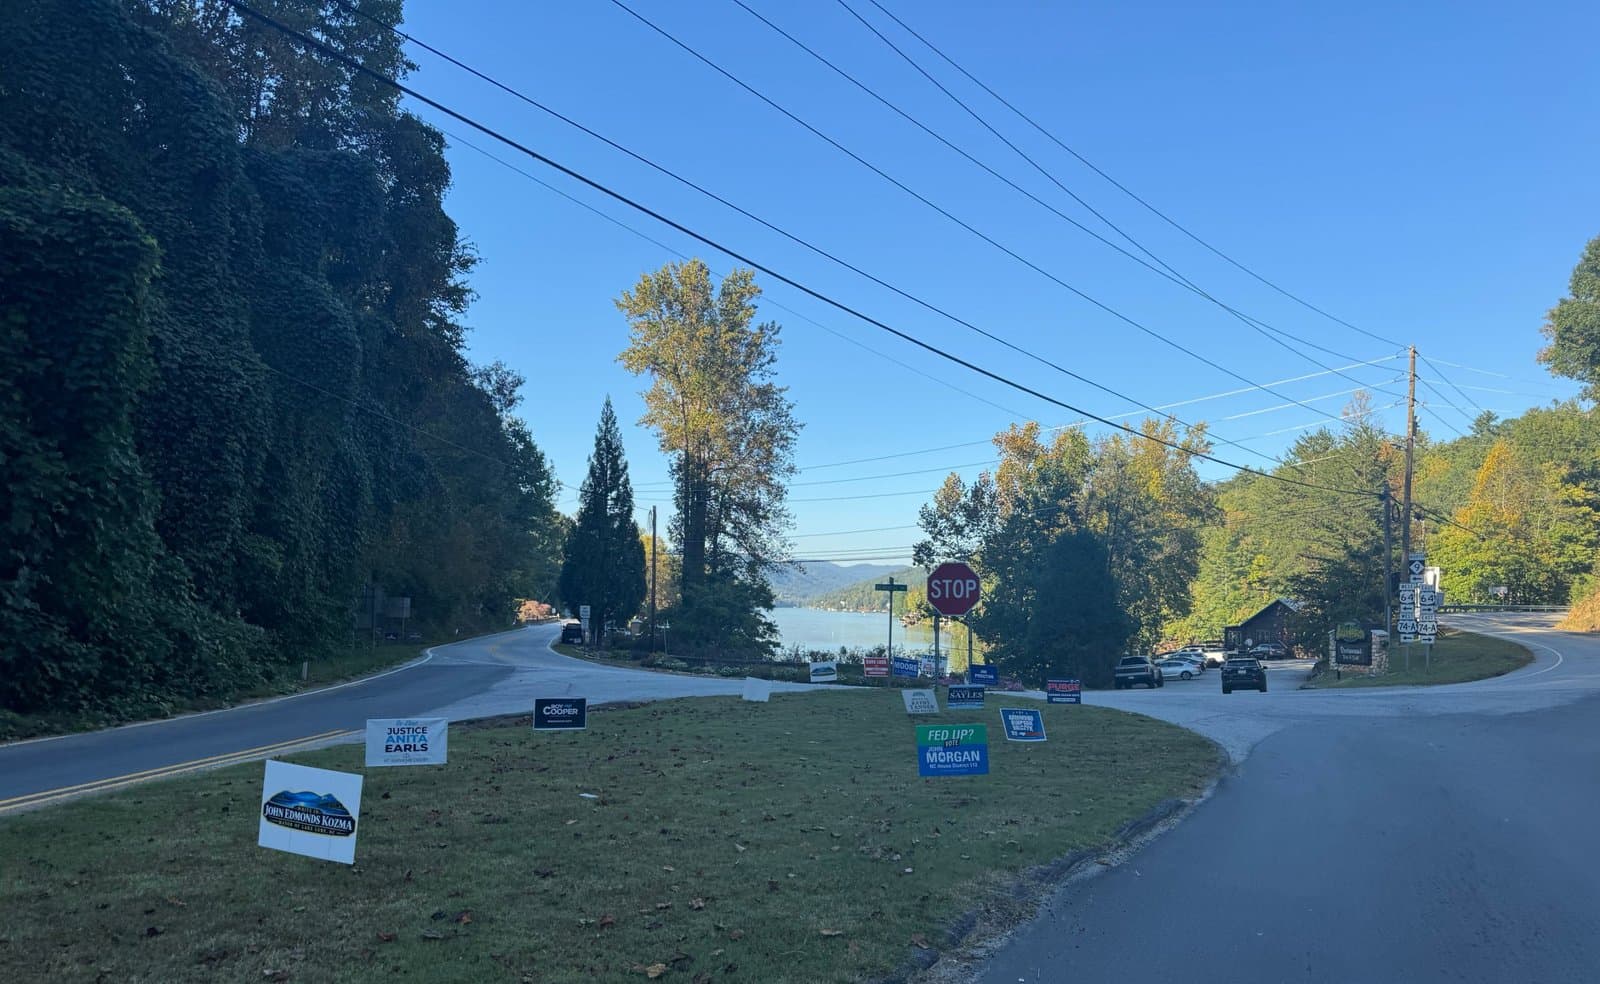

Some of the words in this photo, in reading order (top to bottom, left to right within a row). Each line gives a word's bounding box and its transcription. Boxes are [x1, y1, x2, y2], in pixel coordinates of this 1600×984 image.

[1414, 563, 1420, 571] 9
[931, 579, 977, 598] STOP
[1401, 594, 1414, 602] 64
[1421, 595, 1434, 603] 64
[1399, 622, 1416, 631] 74-A
[1419, 624, 1436, 632] 74-A
[894, 661, 918, 672] MOORE
[950, 691, 983, 699] SAYLES
[387, 727, 428, 735] JUSTICE
[928, 730, 949, 741] FED
[952, 729, 974, 740] UP?
[386, 735, 428, 743] ANITA
[385, 743, 429, 752] EARLS
[926, 750, 980, 764] MORGAN
[265, 804, 284, 818] JOHN
[285, 808, 321, 825] EDMONDS
[322, 815, 353, 831] KOZMA
